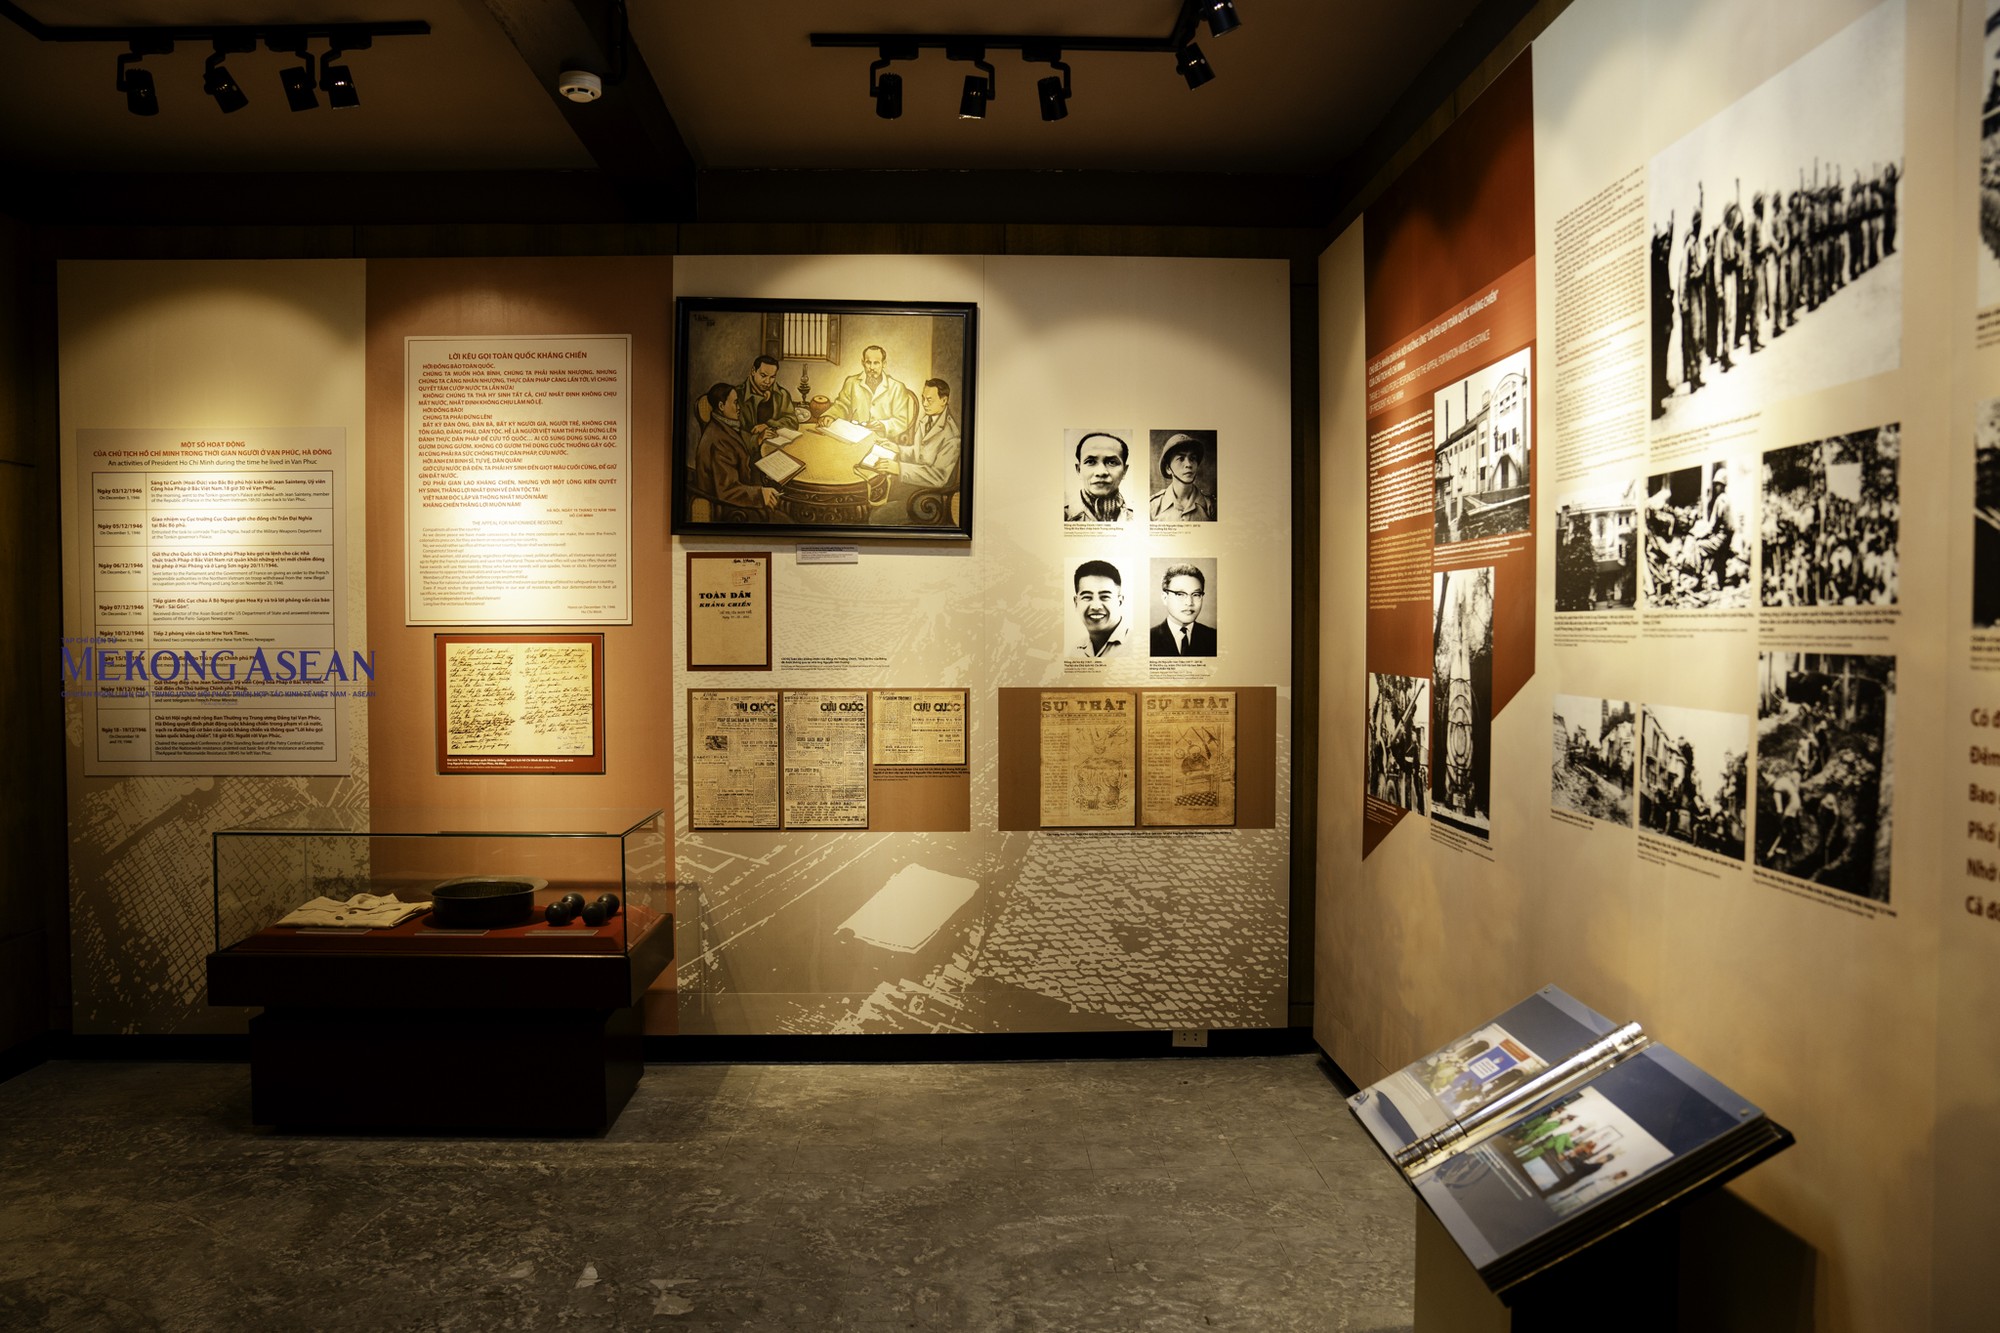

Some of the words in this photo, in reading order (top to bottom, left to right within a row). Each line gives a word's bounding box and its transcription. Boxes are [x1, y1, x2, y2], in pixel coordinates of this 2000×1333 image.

[699, 591, 726, 599] TOÀN
[839, 701, 863, 711] QUỐC
[1042, 701, 1068, 713] SỰ
[1077, 698, 1126, 712] THẬT
[1147, 699, 1172, 711] SỰ
[1181, 696, 1229, 710] THẬT
